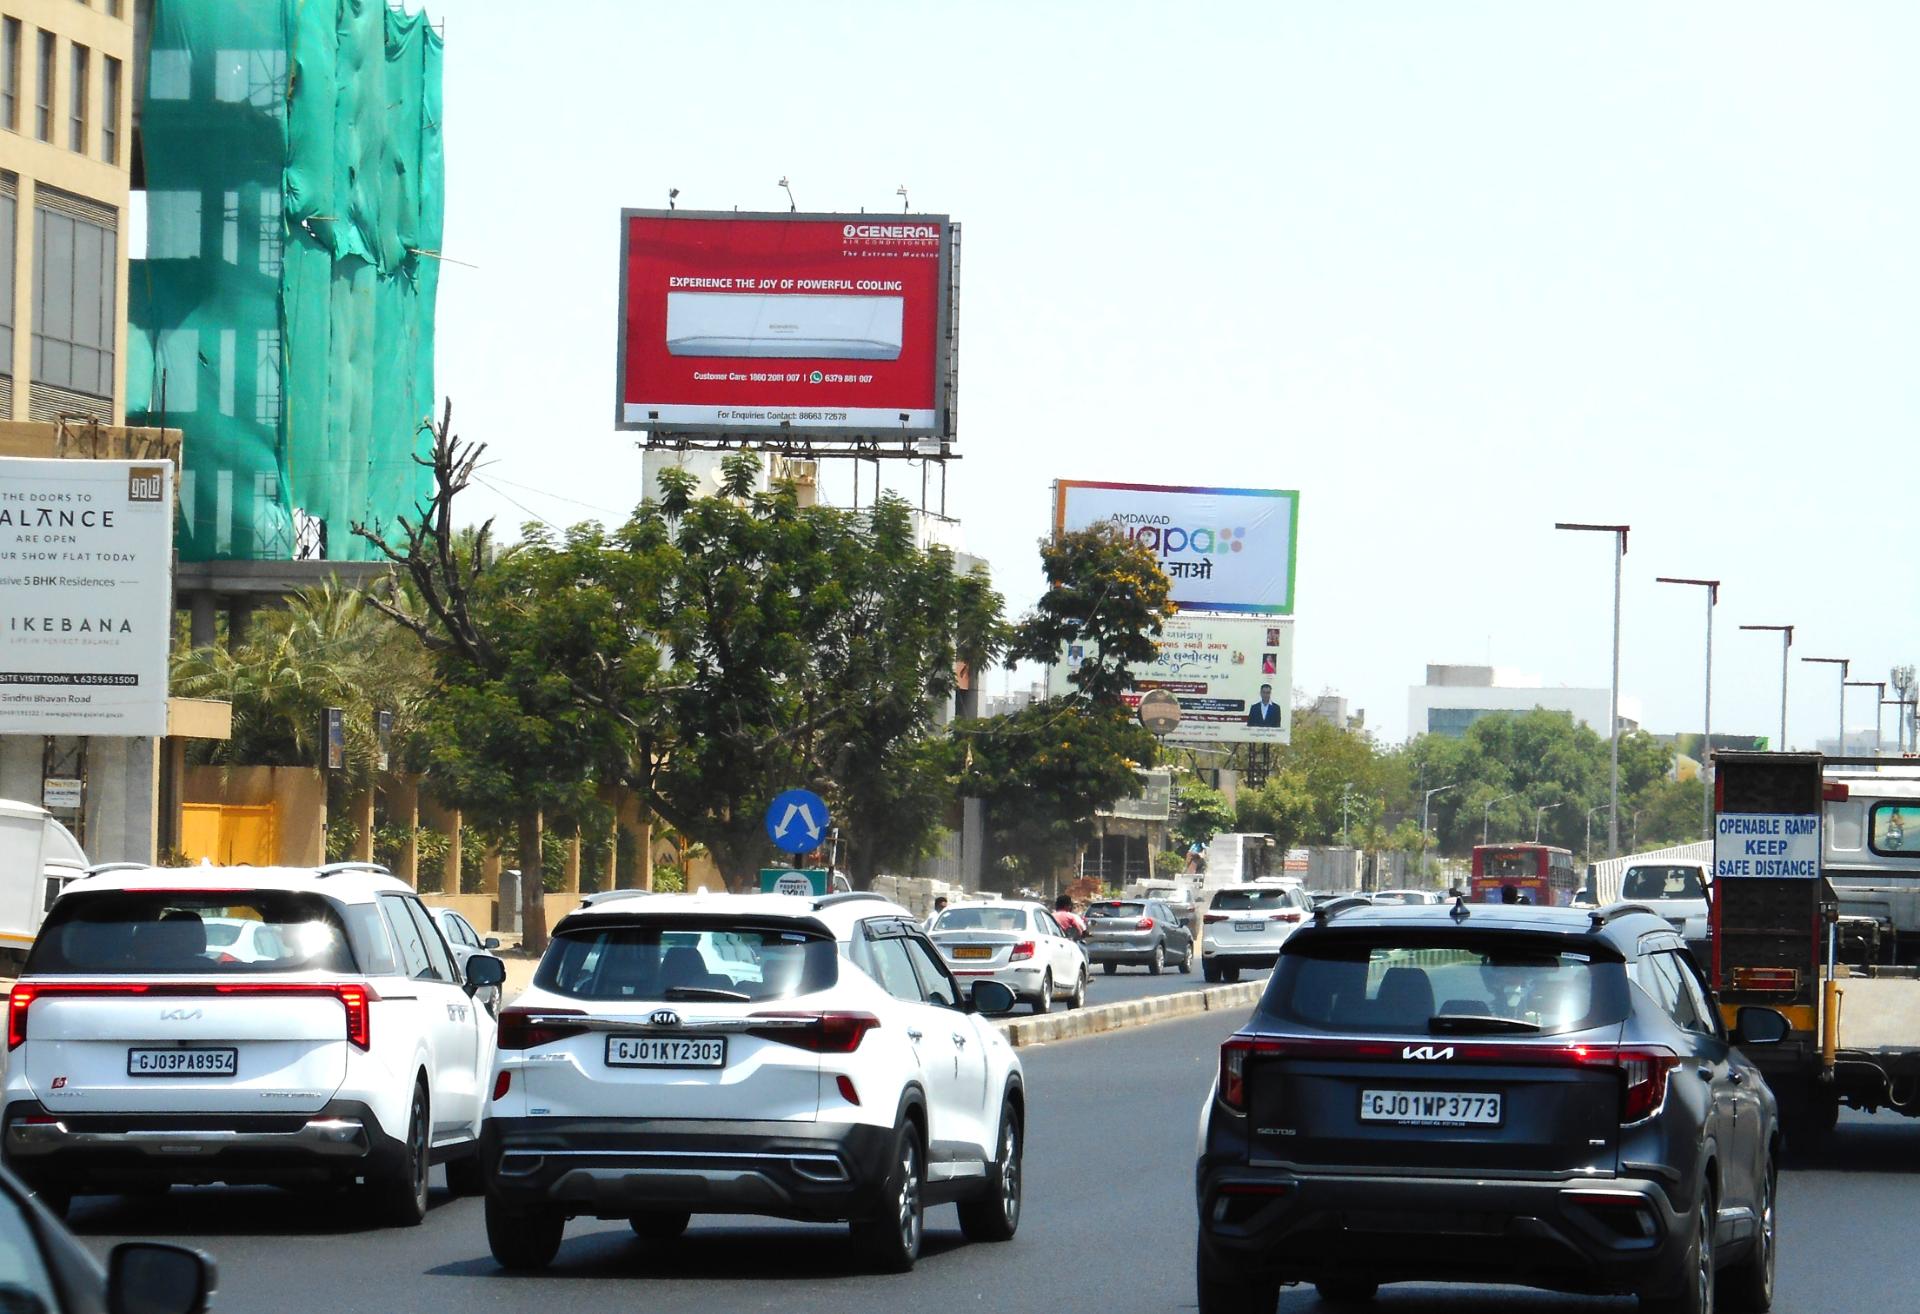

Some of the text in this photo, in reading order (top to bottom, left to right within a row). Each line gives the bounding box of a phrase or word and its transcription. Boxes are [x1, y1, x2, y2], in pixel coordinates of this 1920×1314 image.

[669, 277, 902, 291] EXPERIENCE THE JOY OF POWERFUL COOLING
[693, 371, 727, 381] Customer
[729, 372, 748, 381] Care:
[717, 411, 729, 420] For
[731, 411, 765, 421] Enquiries
[767, 412, 797, 421] Contact:
[3, 493, 92, 502] THE DOORS TO
[0, 508, 114, 528] ALANCE
[1111, 513, 1170, 525] AMDAVAD
[16, 534, 77, 544] ARE OPEN
[1120, 526, 1217, 558] apa
[0, 552, 136, 562] UR SHOW FLAT TODAY
[0, 575, 116, 587] sive 5 BHK Residences
[11, 616, 132, 633] IKEBANA
[0, 674, 18, 683] SITE
[20, 674, 40, 683] VISIT
[42, 675, 70, 684] TODAY
[34, 694, 67, 703] Bhavan
[68, 694, 92, 703] Road
[1720, 819, 1817, 835] OPENABLE RAMP
[1745, 840, 1788, 855] KEEP
[1719, 860, 1815, 876] SAFE DISTANCE
[653, 1013, 677, 1024] KIA
[618, 1042, 721, 1060] GJ01KY2303
[139, 1054, 233, 1070] GJ03PA8954
[1372, 1095, 1499, 1119] GJ01WP3773
[1257, 1128, 1297, 1136] SELTOS
